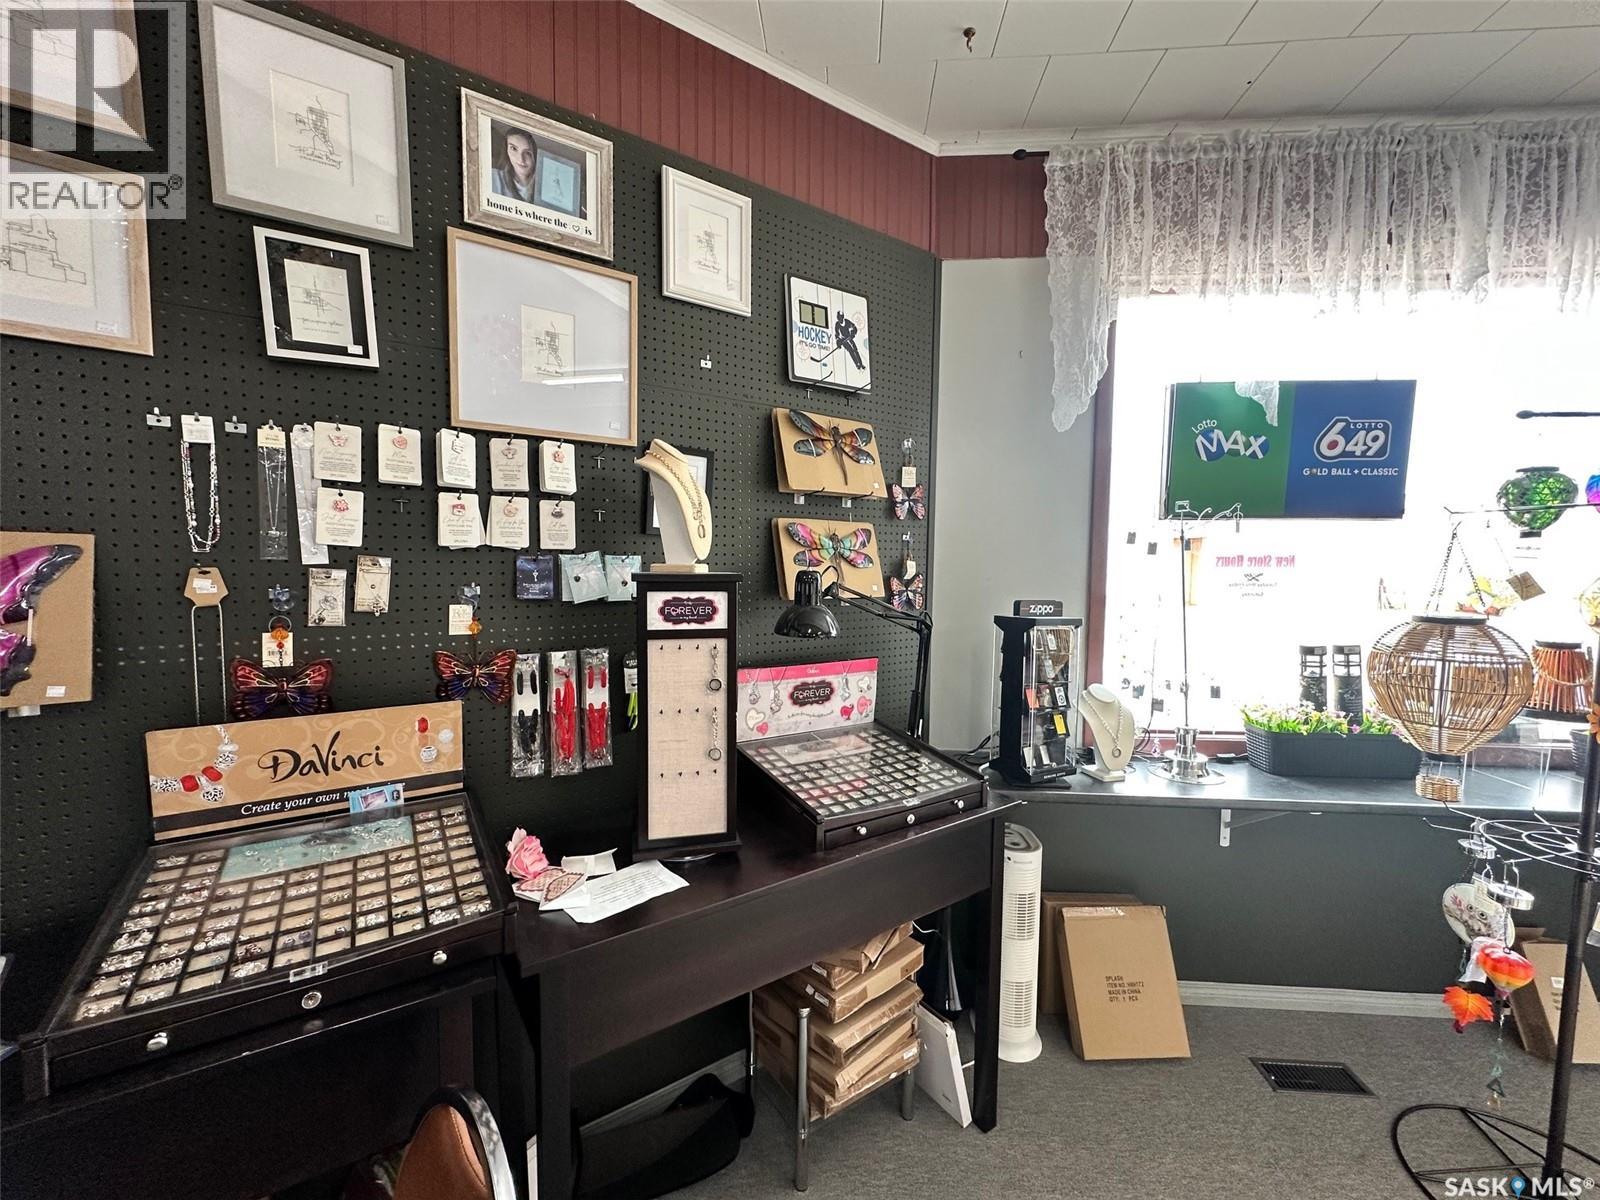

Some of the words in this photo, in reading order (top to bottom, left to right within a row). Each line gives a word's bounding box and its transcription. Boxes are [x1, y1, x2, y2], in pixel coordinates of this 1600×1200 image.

[486, 198, 513, 213] home
[515, 206, 523, 216] is
[525, 211, 553, 225] where
[554, 218, 568, 229] the
[584, 226, 593, 236] is
[798, 325, 832, 344] HOCKEY
[1191, 419, 1218, 434] Lotto
[1195, 428, 1267, 462] MAX
[1319, 421, 1386, 457] 649
[1331, 467, 1352, 476] BALL
[1361, 467, 1399, 476] CLASSIC
[664, 606, 713, 616] FOREVER
[793, 687, 831, 699] FOREVER
[257, 730, 385, 784] DaVinci
[240, 802, 282, 816] Create
[283, 796, 313, 812] your
[315, 793, 340, 804] own
